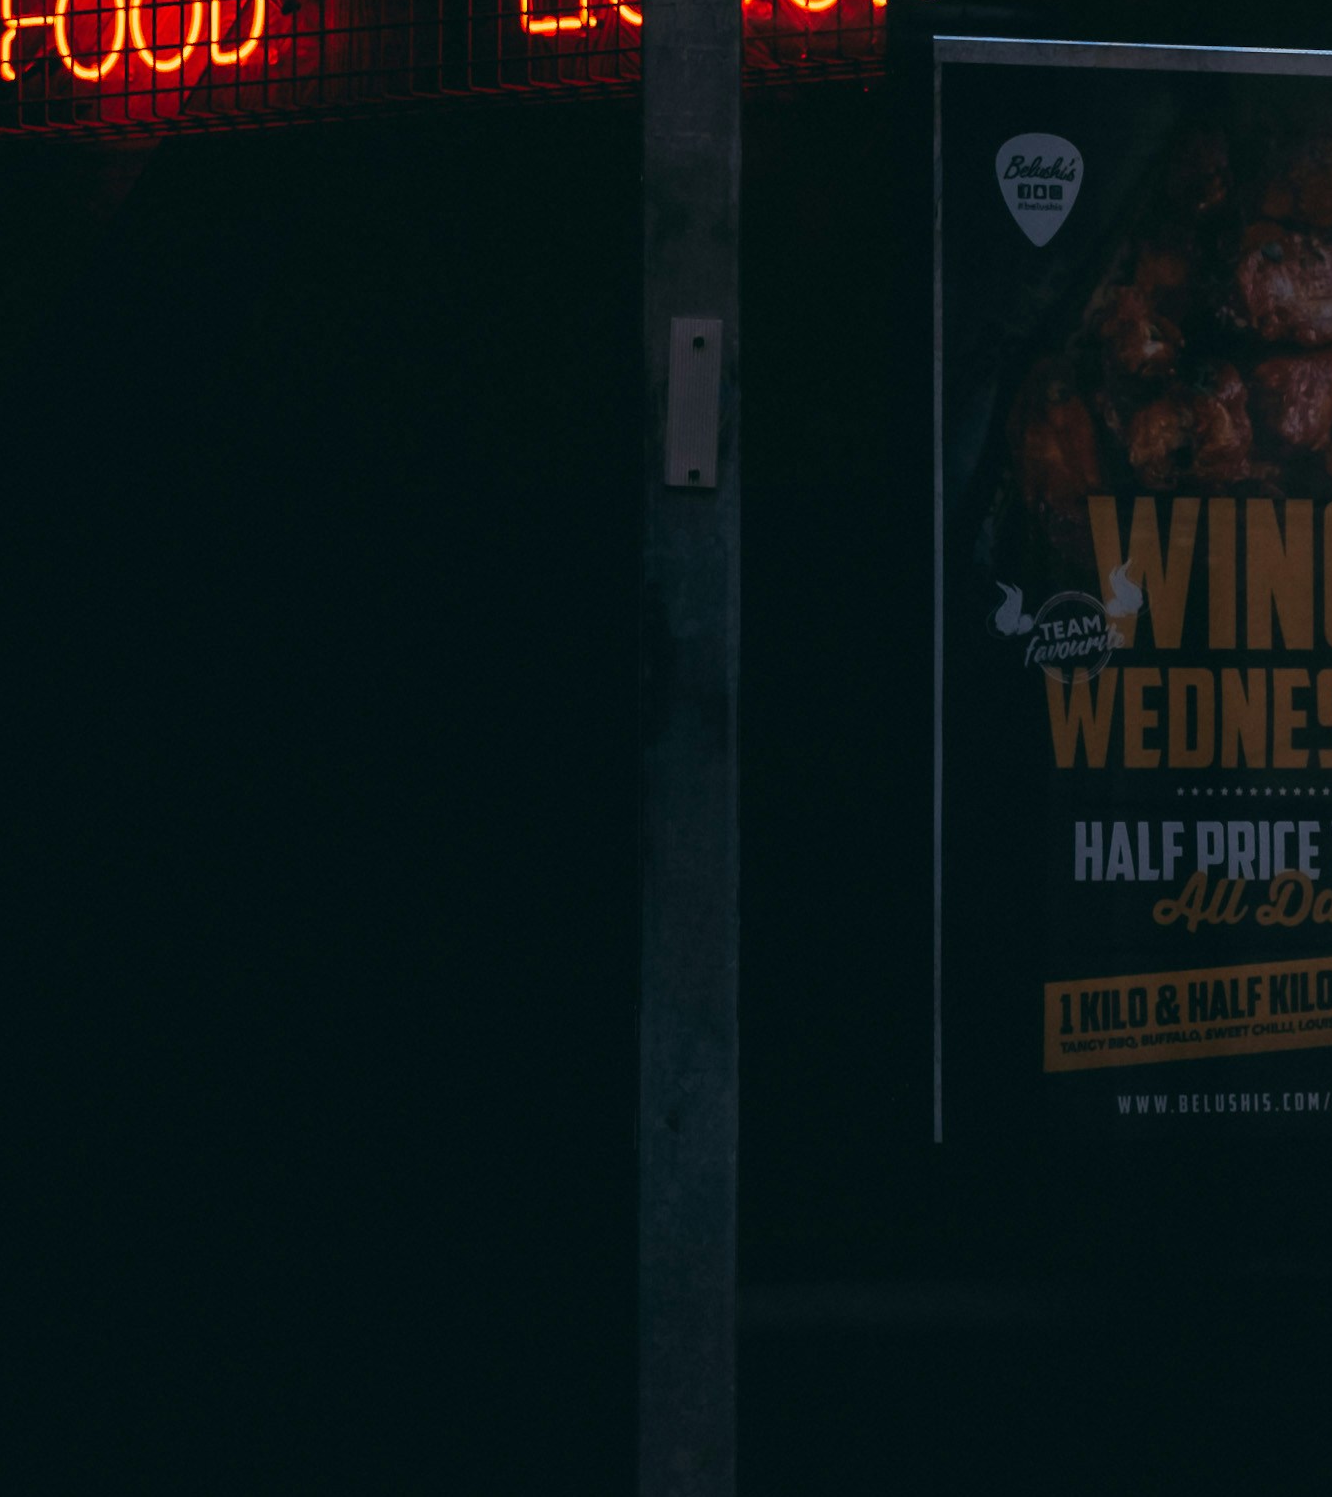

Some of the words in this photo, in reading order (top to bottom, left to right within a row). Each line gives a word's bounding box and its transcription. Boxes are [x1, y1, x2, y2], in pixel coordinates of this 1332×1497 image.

[1004, 155, 1077, 182] Belushi's
[1024, 622, 1126, 668] favourite
[1039, 615, 1102, 642] TEAM
[1074, 820, 1186, 882] HALF
[1196, 820, 1321, 881] PRICE
[1152, 870, 1248, 934] All
[1059, 993, 1073, 1035] 1
[1079, 983, 1149, 1033] KILO
[1155, 982, 1180, 1026] &
[1188, 975, 1262, 1022] HALF
[1205, 1025, 1250, 1040] SWEET
